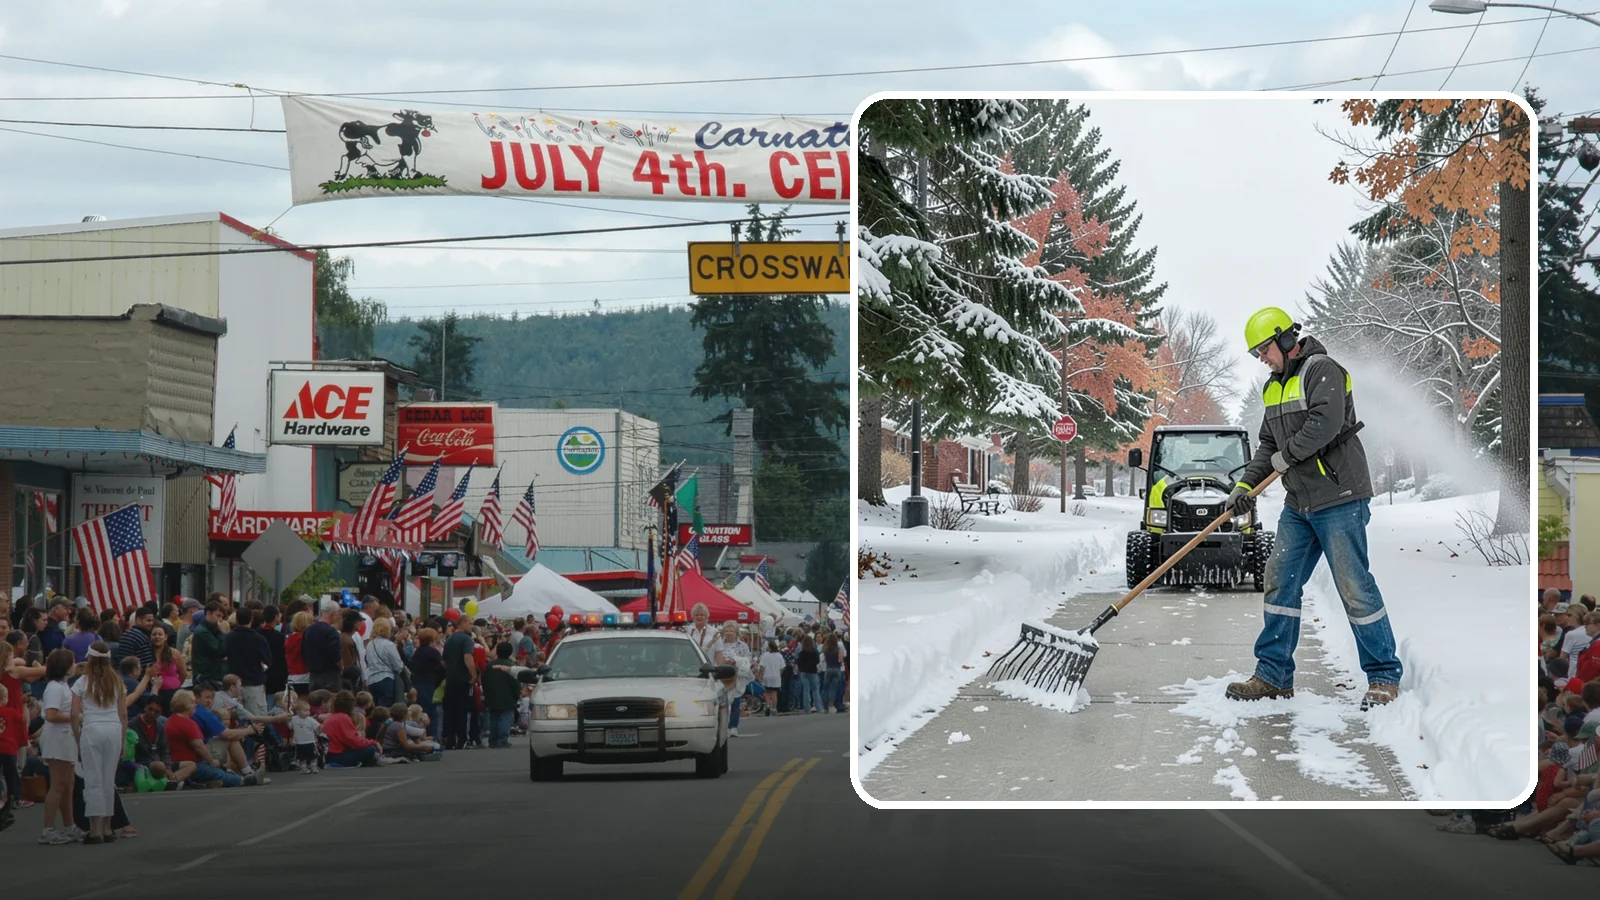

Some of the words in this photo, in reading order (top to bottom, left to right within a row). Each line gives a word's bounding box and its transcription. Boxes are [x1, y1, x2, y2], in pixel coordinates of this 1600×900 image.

[481, 141, 605, 192] JULY
[632, 149, 746, 197] 4th.
[697, 254, 850, 279] CROSSWA
[283, 380, 373, 420] ACE
[405, 409, 452, 421] CEDAR
[461, 409, 485, 421] LOG
[283, 421, 370, 436] Hardware
[416, 428, 477, 446] Coca-Cola
[354, 467, 384, 480] Simpl
[95, 485, 124, 494] Vincent
[126, 486, 135, 494] de
[137, 486, 155, 495] Paul
[688, 526, 741, 535] CRNATION
[699, 535, 730, 543] GLASS
